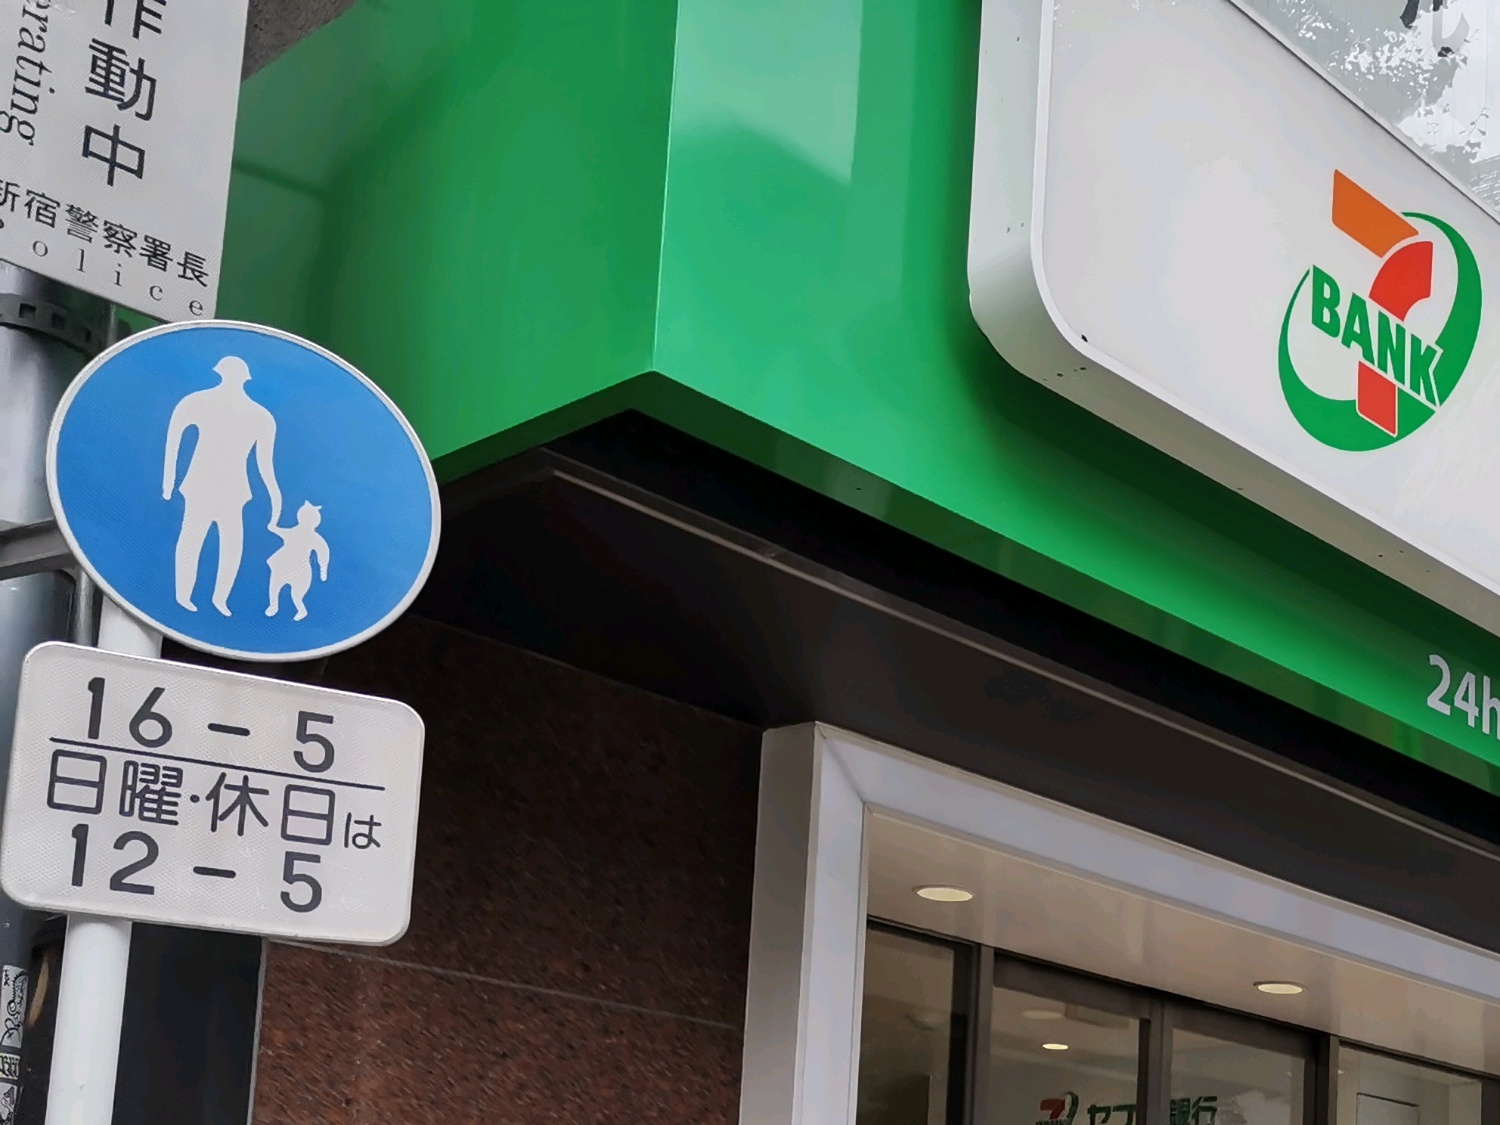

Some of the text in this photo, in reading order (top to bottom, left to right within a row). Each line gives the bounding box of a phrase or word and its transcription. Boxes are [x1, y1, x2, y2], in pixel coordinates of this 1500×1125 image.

[1311, 264, 1438, 407] BANK
[47, 748, 382, 850] 日曜・休日は
